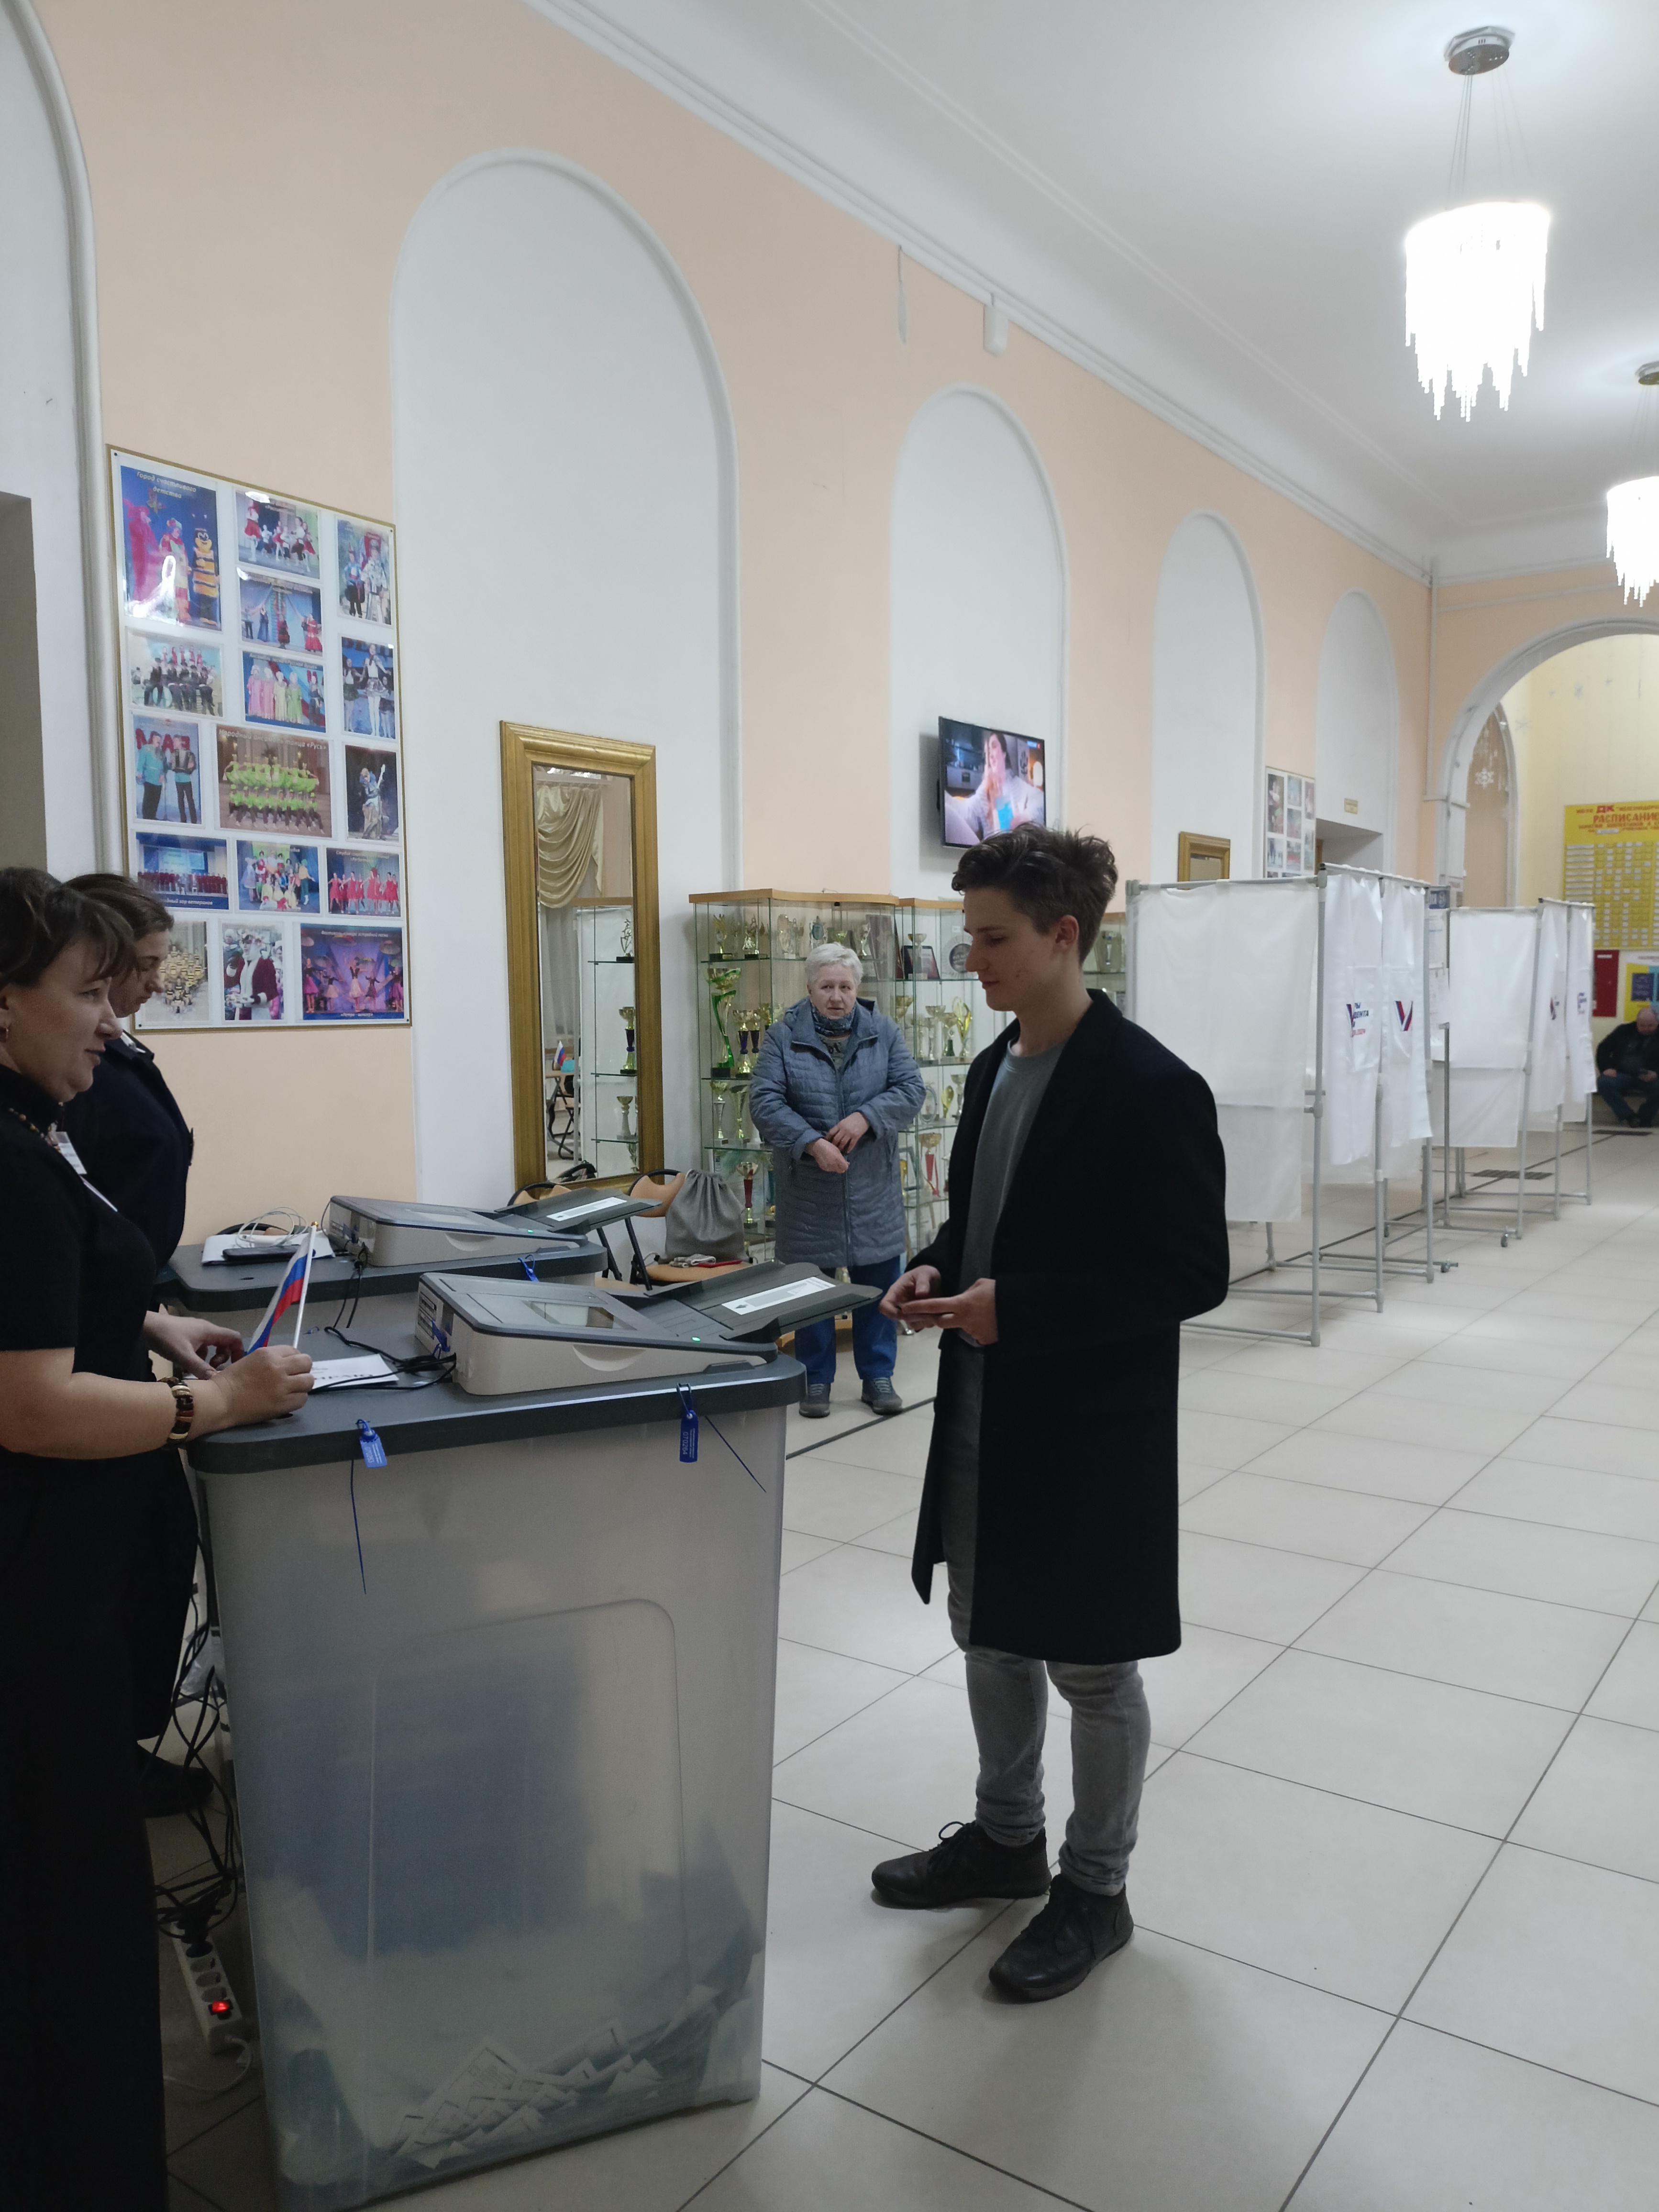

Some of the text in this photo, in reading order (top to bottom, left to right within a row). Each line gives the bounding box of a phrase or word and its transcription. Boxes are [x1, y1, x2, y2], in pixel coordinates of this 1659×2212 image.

[137, 471, 197, 493] Город счастливого
[152, 486, 182, 499] детства
[219, 729, 252, 740] Народный
[285, 739, 306, 748] танца
[307, 741, 327, 750] «Русь»
